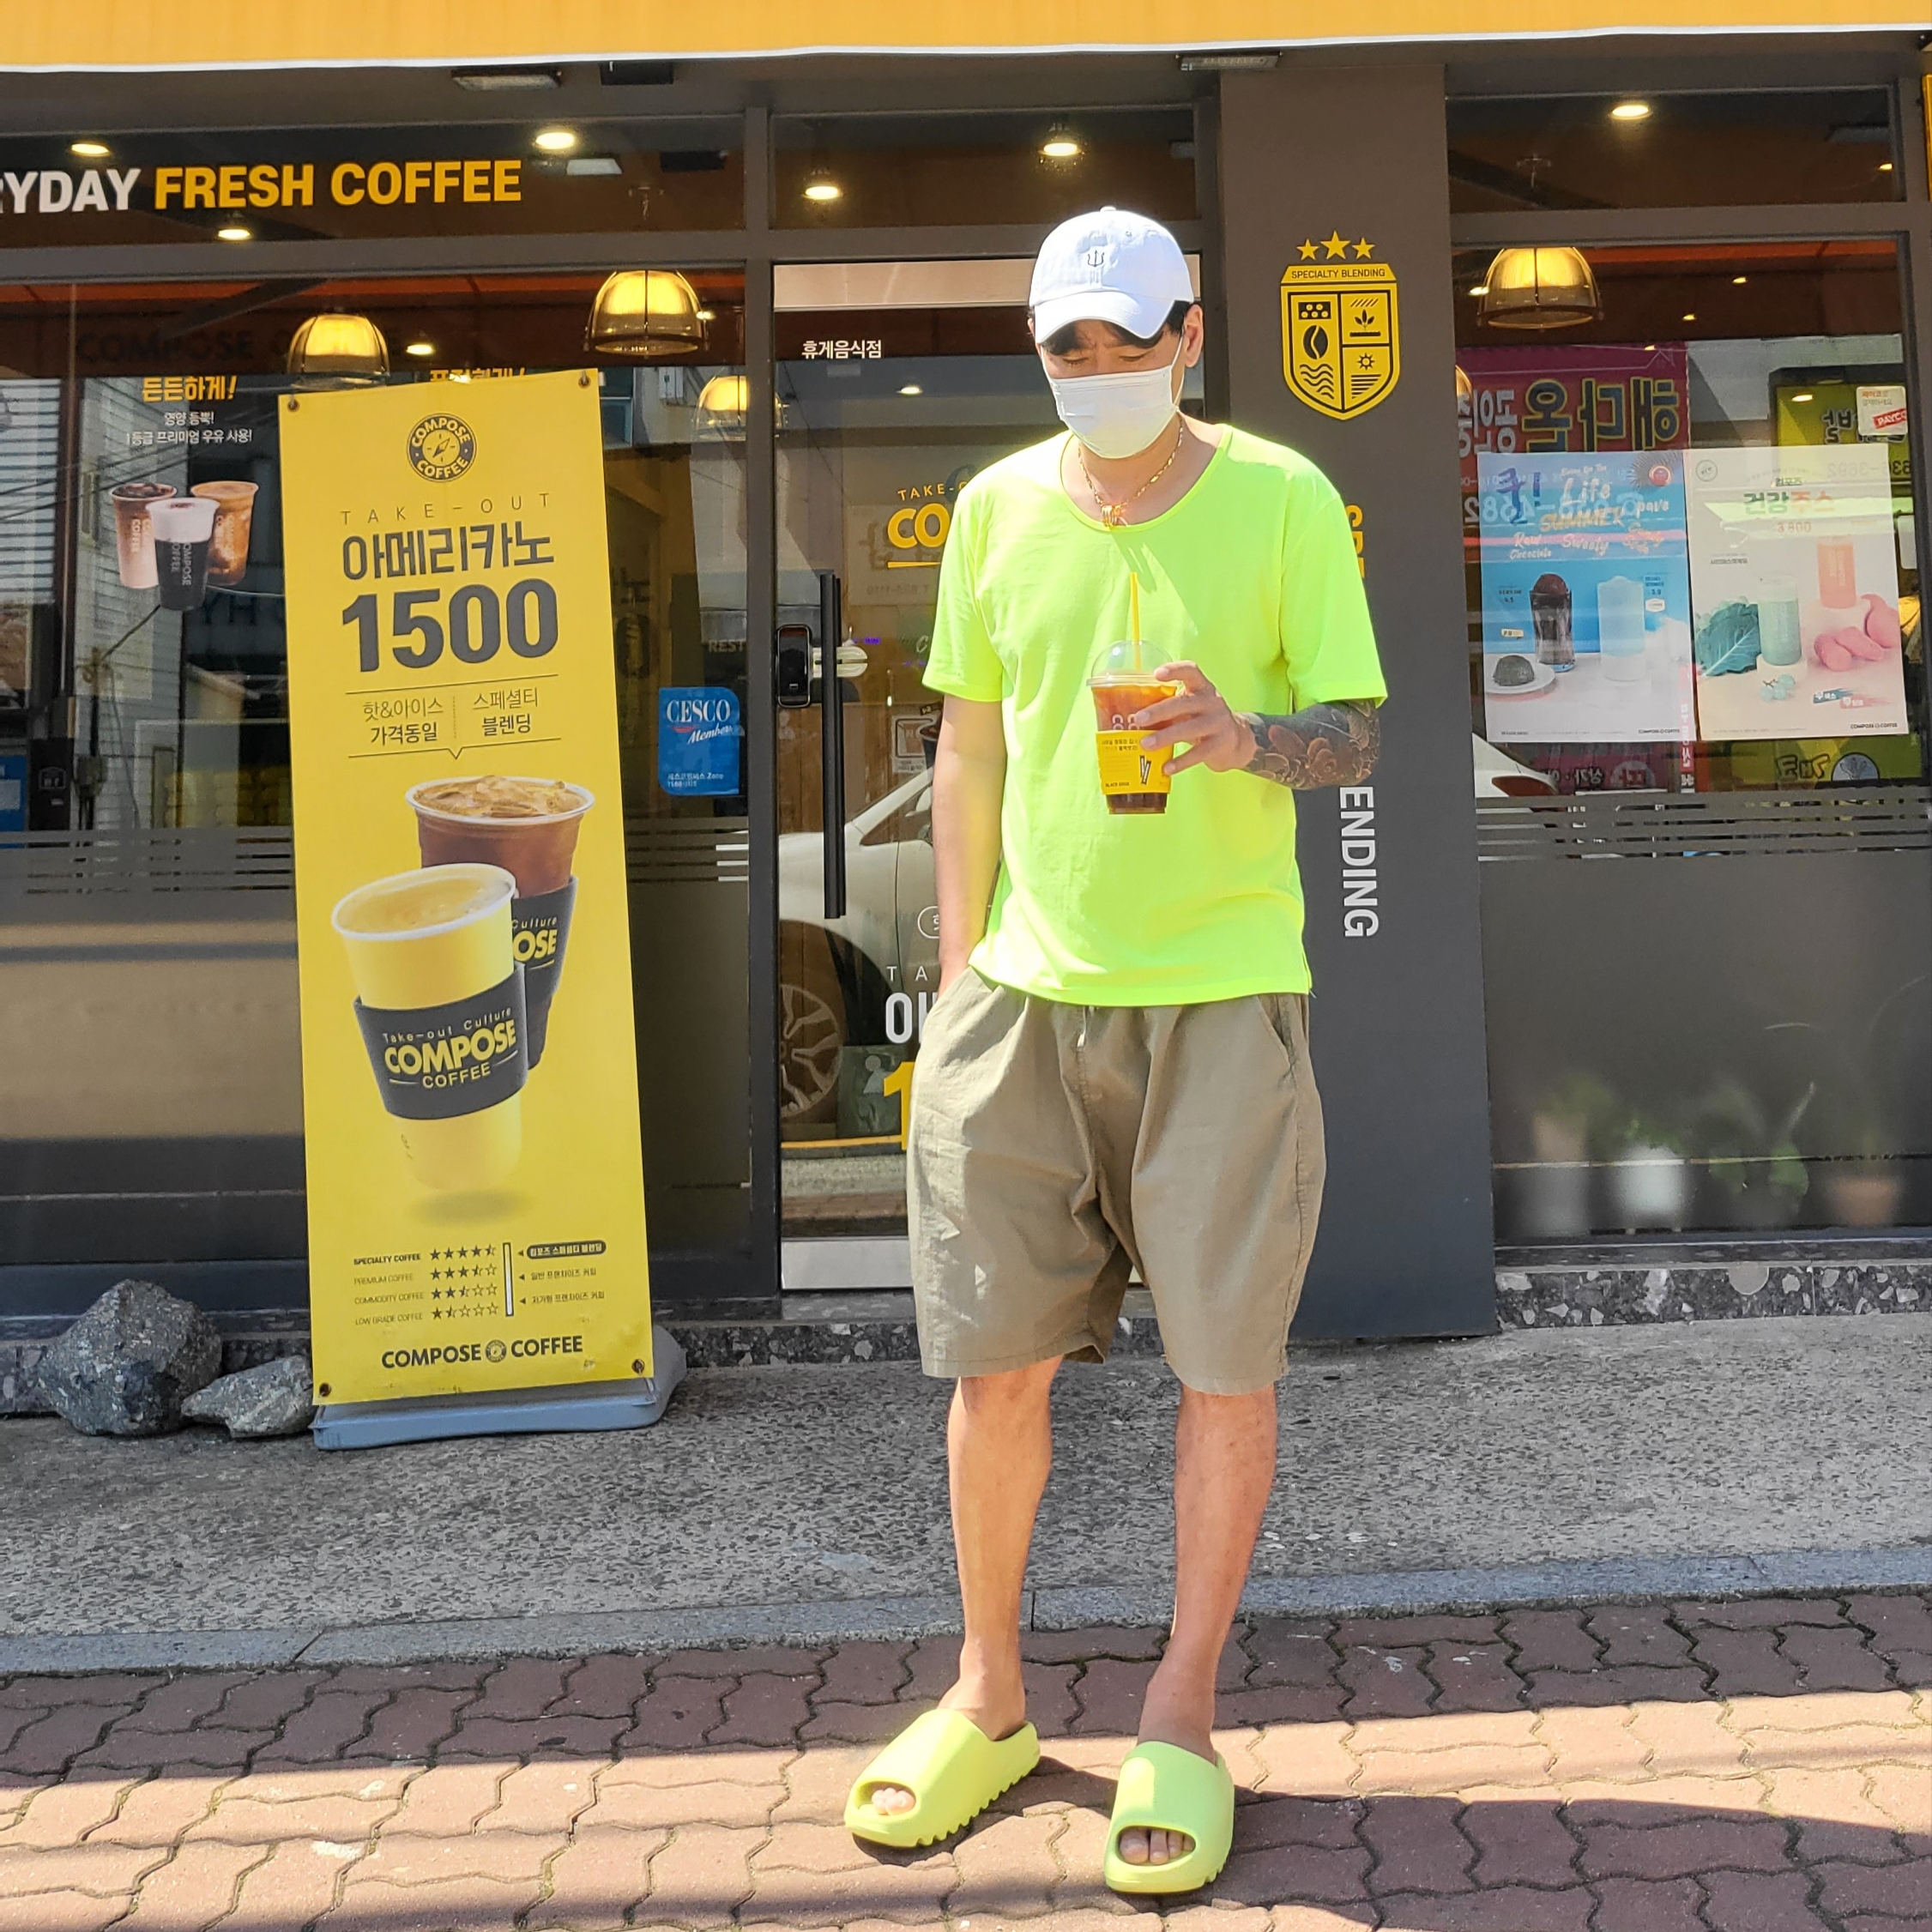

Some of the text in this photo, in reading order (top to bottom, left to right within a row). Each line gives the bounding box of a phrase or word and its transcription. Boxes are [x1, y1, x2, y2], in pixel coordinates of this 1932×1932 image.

[154, 165, 314, 211] FRESH
[330, 160, 522, 206] COFFEE
[1291, 268, 1386, 280] SPECIALTY BLENDING
[801, 340, 882, 360] 휴게음식점
[142, 375, 238, 402] 든든하게!
[163, 412, 187, 427] 영양
[156, 430, 200, 444] 프리미엄
[202, 431, 225, 444] 우유
[411, 417, 472, 448] COMPOSE
[416, 456, 469, 480] COFFEE
[341, 492, 550, 526] TAKE-OUT
[342, 521, 555, 581] 아메리카노
[341, 577, 558, 673] 1500
[363, 697, 444, 722] 핫&아이스
[472, 687, 539, 711] 스페셜티
[666, 698, 731, 723] CESCO
[371, 721, 438, 746] 가격동일
[481, 713, 532, 737] 블렌딩
[1339, 786, 1380, 938] ENDING
[383, 1007, 512, 1044] Take-out Culture
[384, 1018, 517, 1075] COMPOSE
[422, 1062, 492, 1088] COFFEE
[353, 1253, 421, 1265] SPECIALTY COFFEE
[583, 1267, 596, 1276] 커피
[353, 1272, 414, 1285] PREMIUM COFFEE
[354, 1291, 425, 1305] COMMODITY COFFEE
[590, 1290, 605, 1300] 커피
[355, 1317, 371, 1325] LOW
[397, 1312, 423, 1322] COFFEE
[381, 1343, 482, 1369] COMPOSE
[510, 1335, 583, 1358] COFFEE
